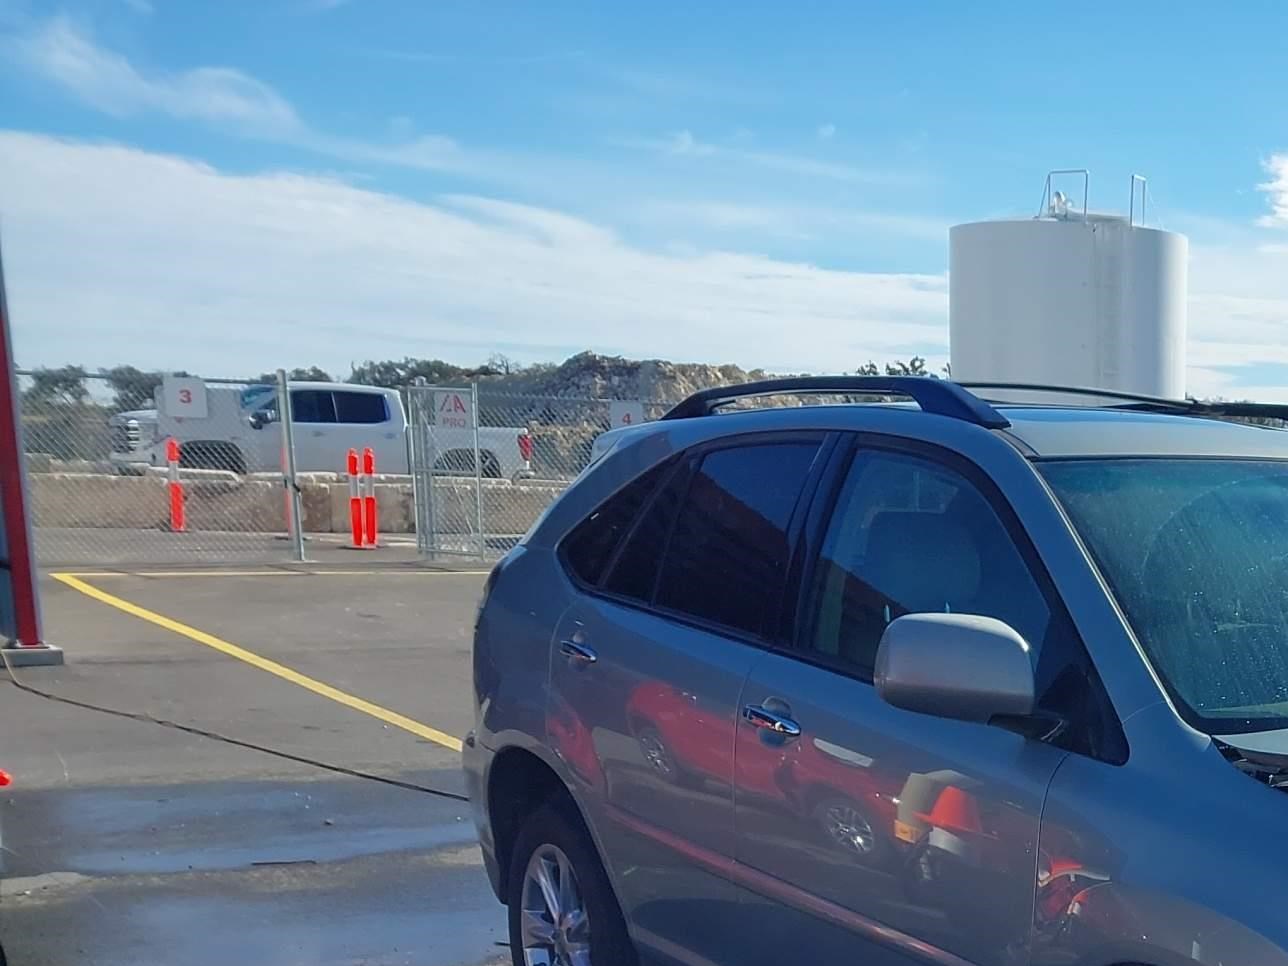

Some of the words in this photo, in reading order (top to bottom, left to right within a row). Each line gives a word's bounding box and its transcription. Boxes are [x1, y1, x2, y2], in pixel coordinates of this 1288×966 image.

[178, 389, 192, 404] 3
[442, 417, 466, 428] PRO
[622, 412, 632, 425] 4
